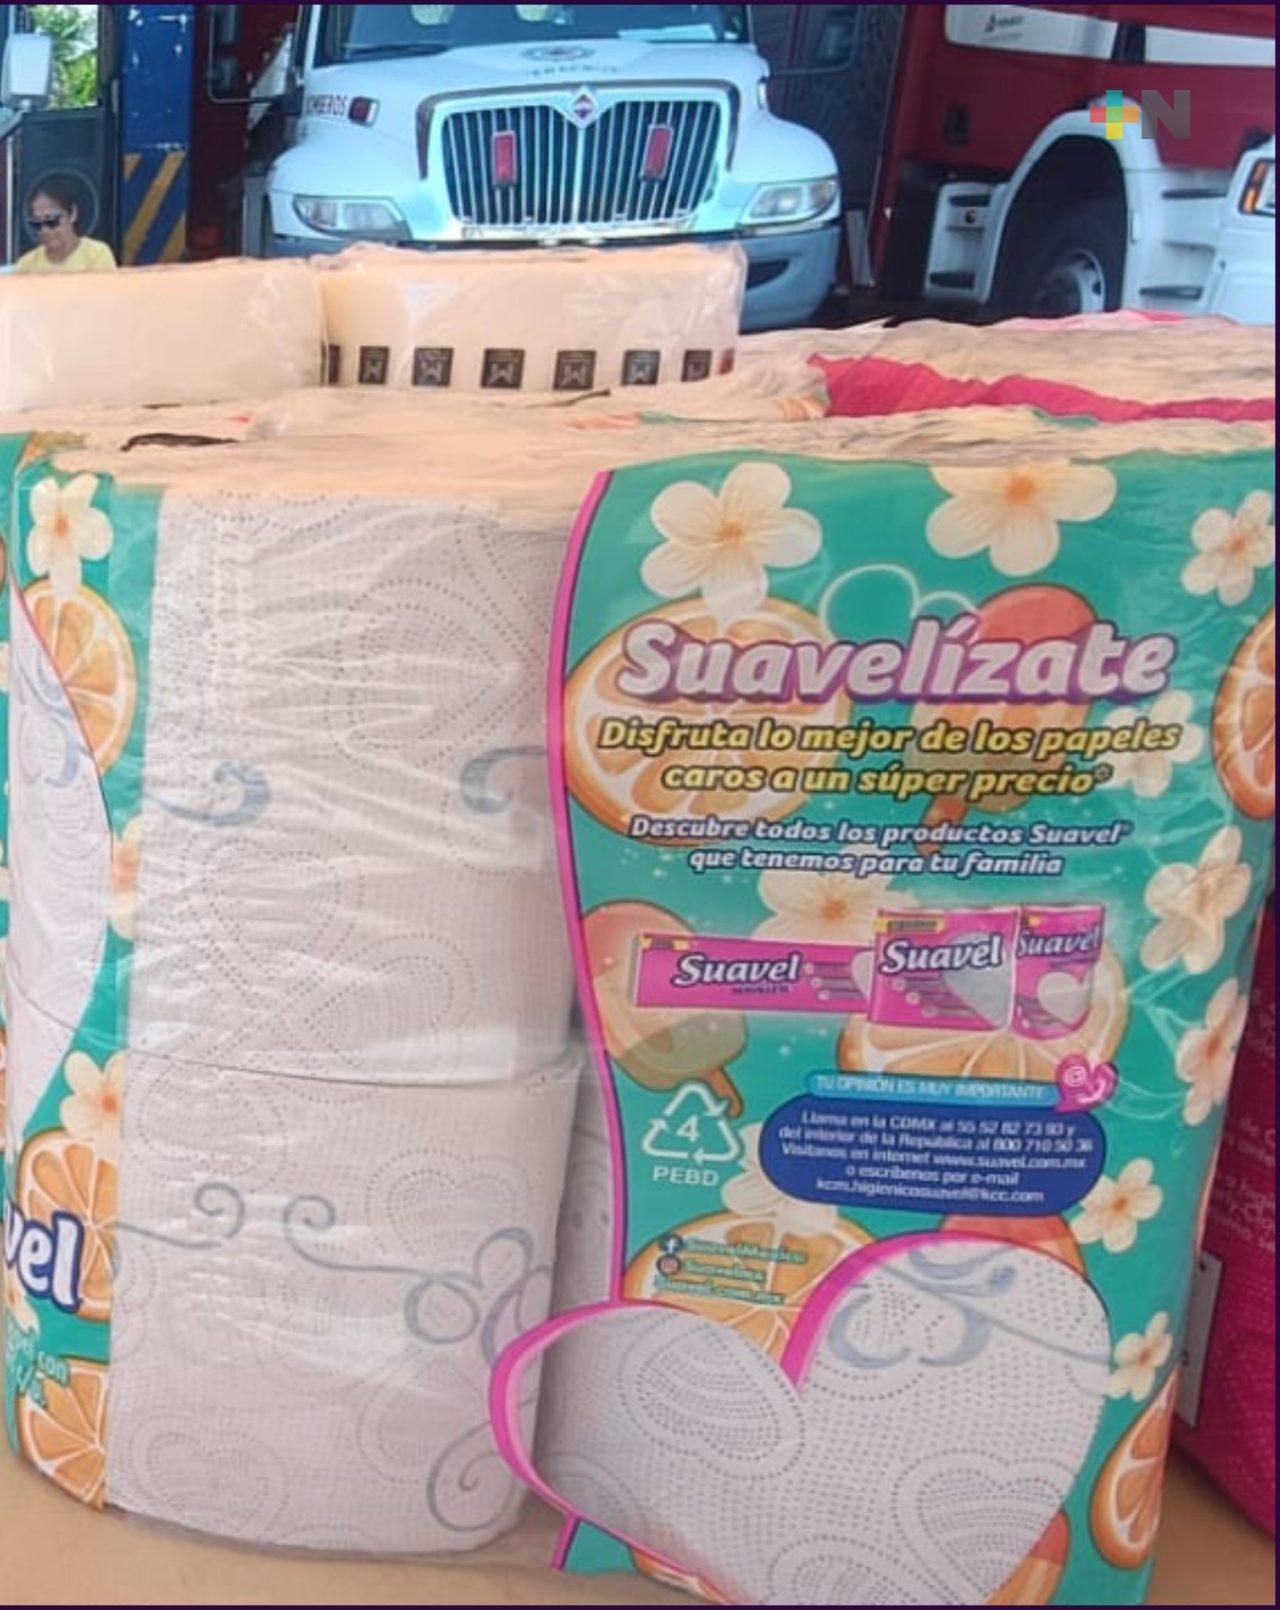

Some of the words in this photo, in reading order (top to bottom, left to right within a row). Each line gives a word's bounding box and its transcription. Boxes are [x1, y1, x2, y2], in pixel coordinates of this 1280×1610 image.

[616, 614, 1180, 702] Suavelízate
[597, 717, 752, 756] Disfruta
[757, 717, 794, 751] lo
[800, 717, 913, 758] mejor
[919, 719, 968, 752] de
[973, 719, 1033, 752] los
[1032, 717, 1184, 761] papeles
[662, 765, 767, 791] caros
[772, 767, 797, 792] a
[802, 769, 852, 793] un
[856, 761, 967, 801] súper
[631, 814, 751, 839] Descubre
[754, 818, 831, 842] todos
[836, 818, 876, 843] los
[879, 822, 1024, 848] productos
[688, 850, 737, 875] que
[740, 847, 856, 872] tenemos
[859, 854, 925, 878] para
[929, 852, 959, 874] tu
[956, 850, 1065, 878] familia
[671, 951, 802, 988] Suavel
[877, 932, 1004, 976] Suavel
[676, 1115, 701, 1143] 4
[850, 1116, 870, 1128] en
[872, 1115, 888, 1129] la
[858, 1131, 880, 1145] de
[652, 1165, 719, 1187] PEBD
[942, 1171, 968, 1184] por
